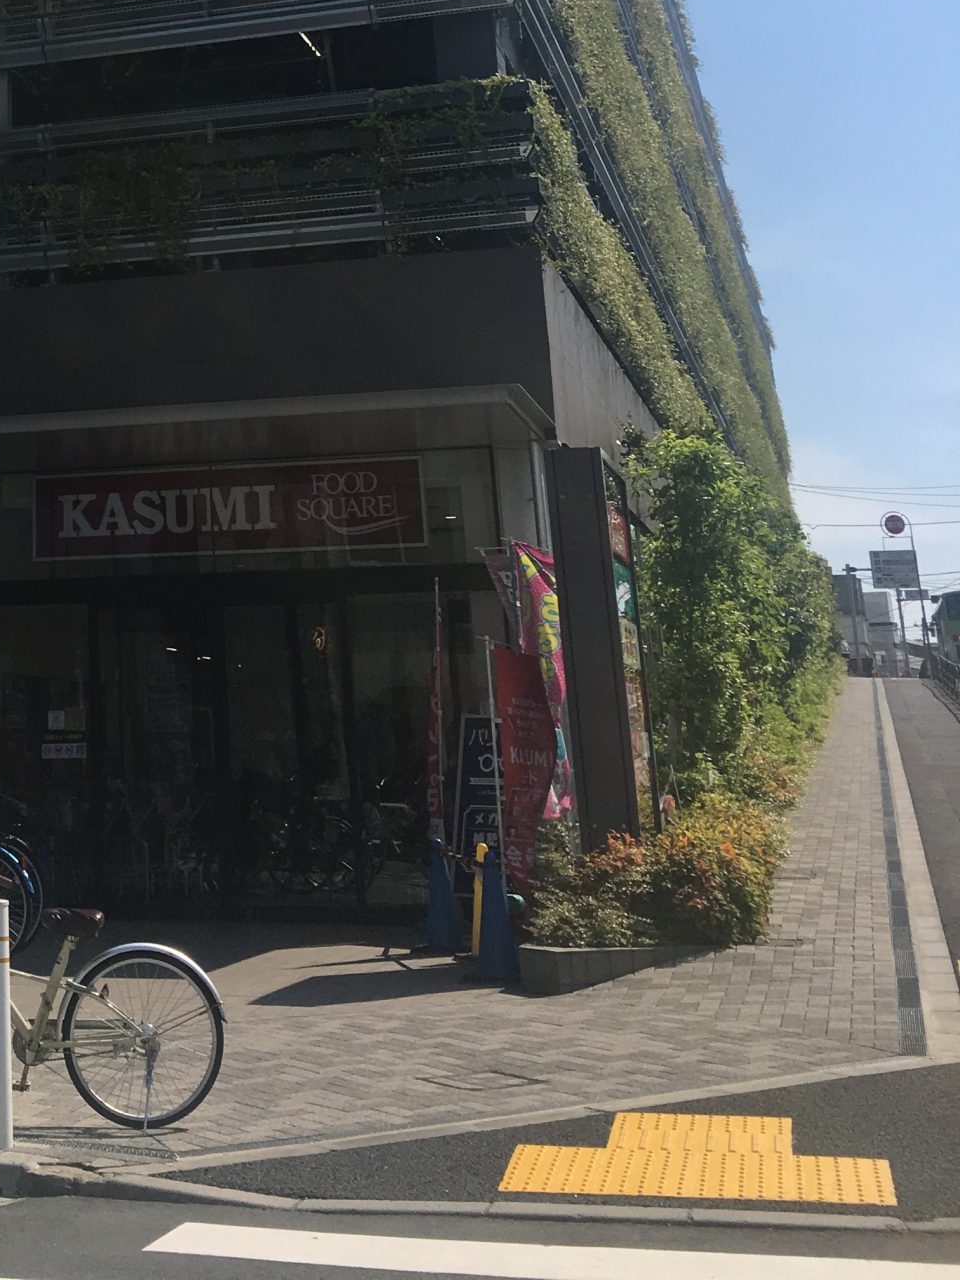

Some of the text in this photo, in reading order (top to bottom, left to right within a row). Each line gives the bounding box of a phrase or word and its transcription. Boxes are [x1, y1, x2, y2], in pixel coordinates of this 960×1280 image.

[311, 471, 378, 495] FOOD
[57, 484, 277, 539] KASUMI
[296, 495, 396, 523] SQUARE
